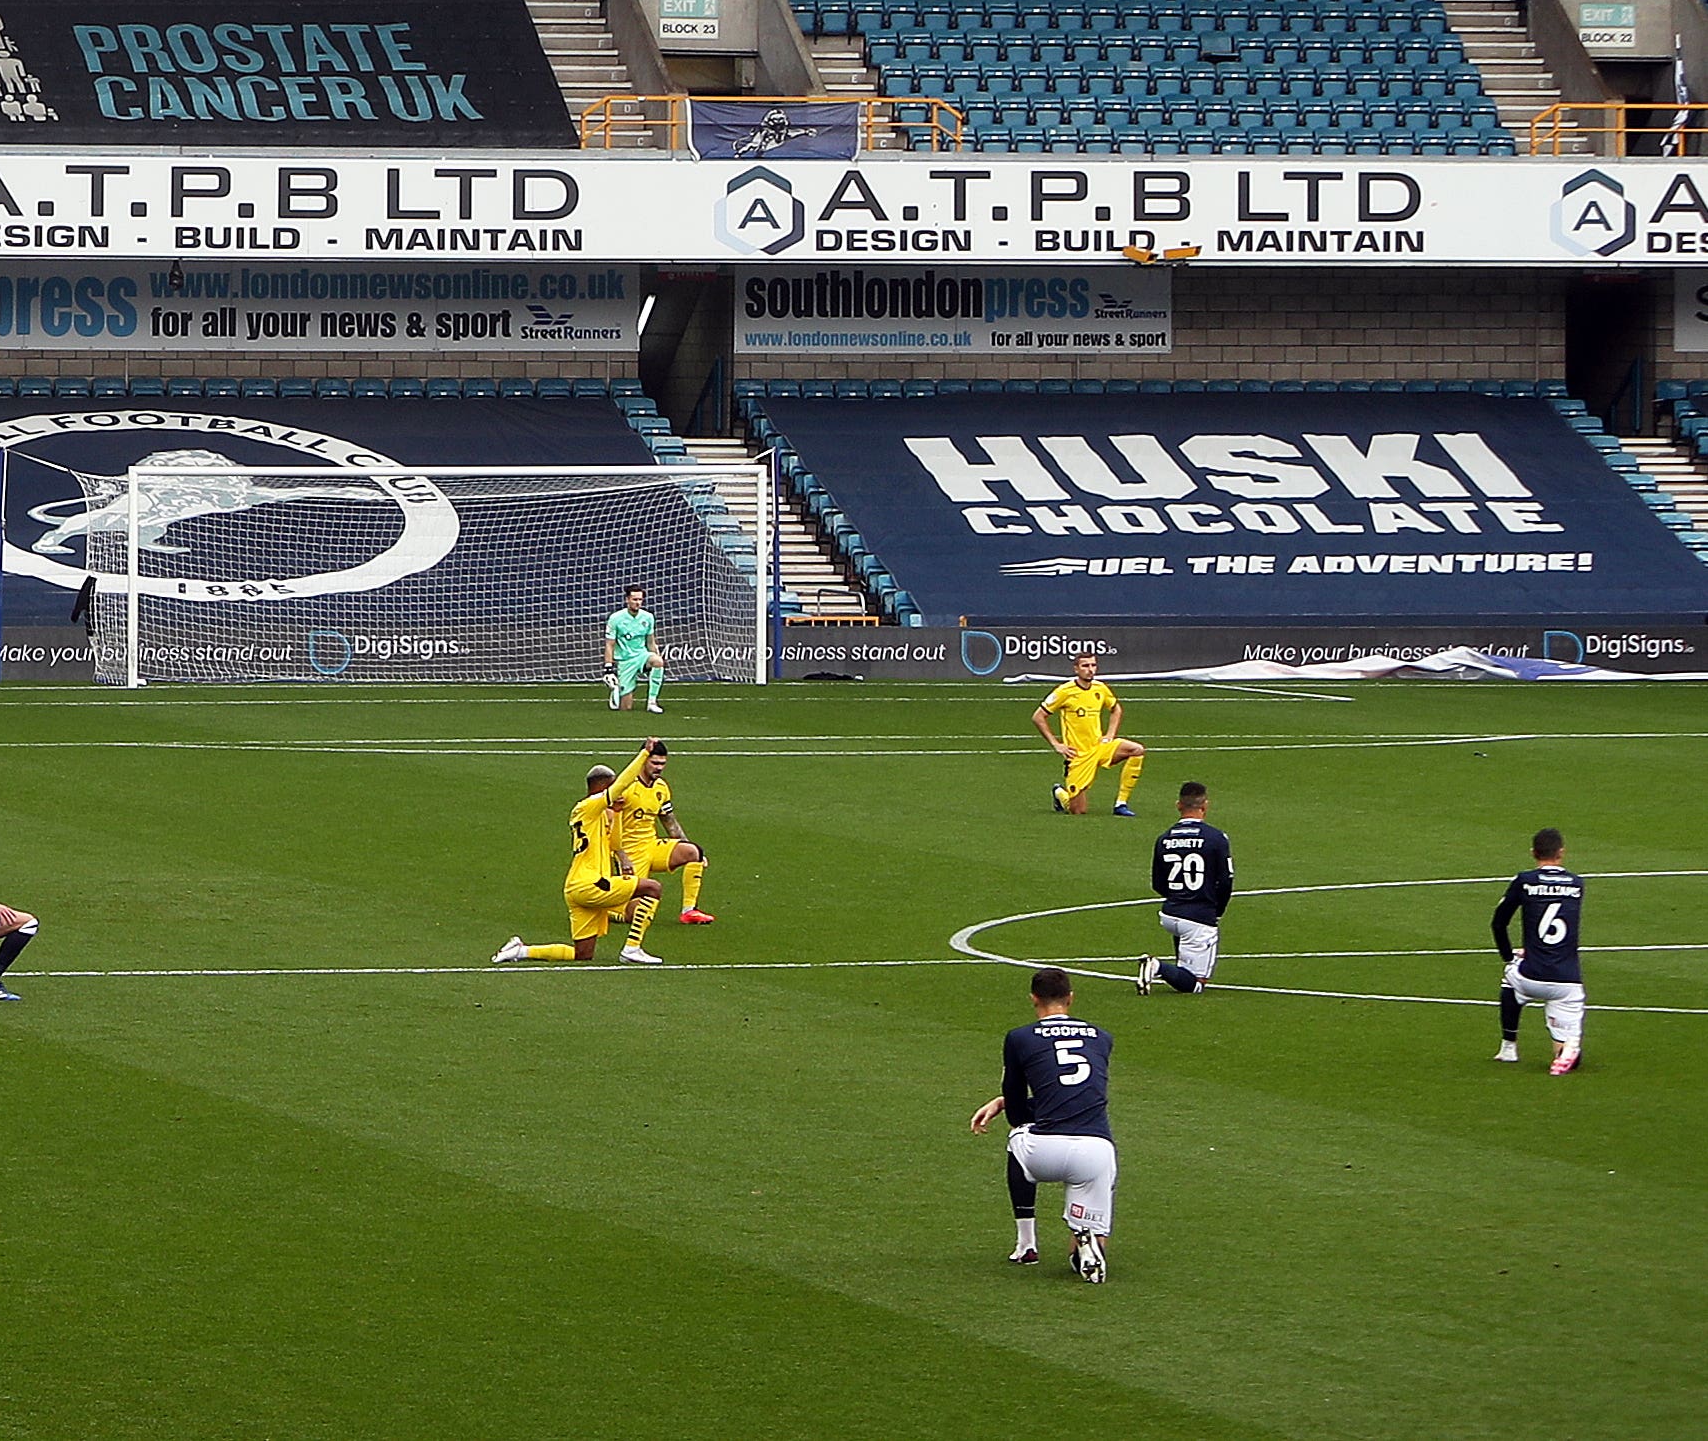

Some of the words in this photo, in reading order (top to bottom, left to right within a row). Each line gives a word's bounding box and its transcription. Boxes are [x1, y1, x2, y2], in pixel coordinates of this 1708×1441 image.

[663, 0, 696, 12] EXIT
[1582, 8, 1614, 22] EXIT
[662, 23, 699, 33] BLOCK
[72, 22, 428, 74] PROSTATE
[92, 75, 380, 122] CANCER
[377, 74, 484, 121] UK
[387, 169, 579, 220] LTD
[1238, 172, 1421, 222] LTD
[175, 227, 300, 249] BUILD
[366, 229, 582, 251] MAINTAIN
[816, 230, 971, 251] DESIGN
[1036, 230, 1155, 251] BUILD
[1218, 231, 1423, 252] MAINTAIN
[150, 269, 625, 299] www.londonnewsonline.co.uk
[745, 270, 1089, 322] southlondonpress
[151, 308, 192, 338] for
[201, 308, 237, 338] all
[246, 312, 313, 342] your
[320, 310, 396, 339] news
[405, 309, 427, 339] &
[435, 309, 512, 342] sport
[745, 331, 972, 347] www.londonnewsonline.co.uk
[991, 331, 1012, 346] for
[1015, 331, 1034, 347] all
[1036, 333, 1069, 348] your
[1072, 333, 1112, 347] news
[1115, 332, 1126, 347] &
[1128, 331, 1167, 348] sport
[48, 410, 338, 455] FOOTBALL
[344, 451, 439, 505] CUB
[903, 433, 1534, 501] HUSKI
[961, 500, 1566, 536] CHOCOLATE
[1033, 555, 1174, 576] FUEL
[1185, 554, 1281, 575] THE
[1288, 552, 1594, 575] ADVENTURE!
[851, 643, 910, 661] stand
[913, 644, 947, 661] out
[1163, 853, 1205, 891] 20
[1538, 902, 1567, 945] 6
[1054, 1039, 1091, 1086] 5
